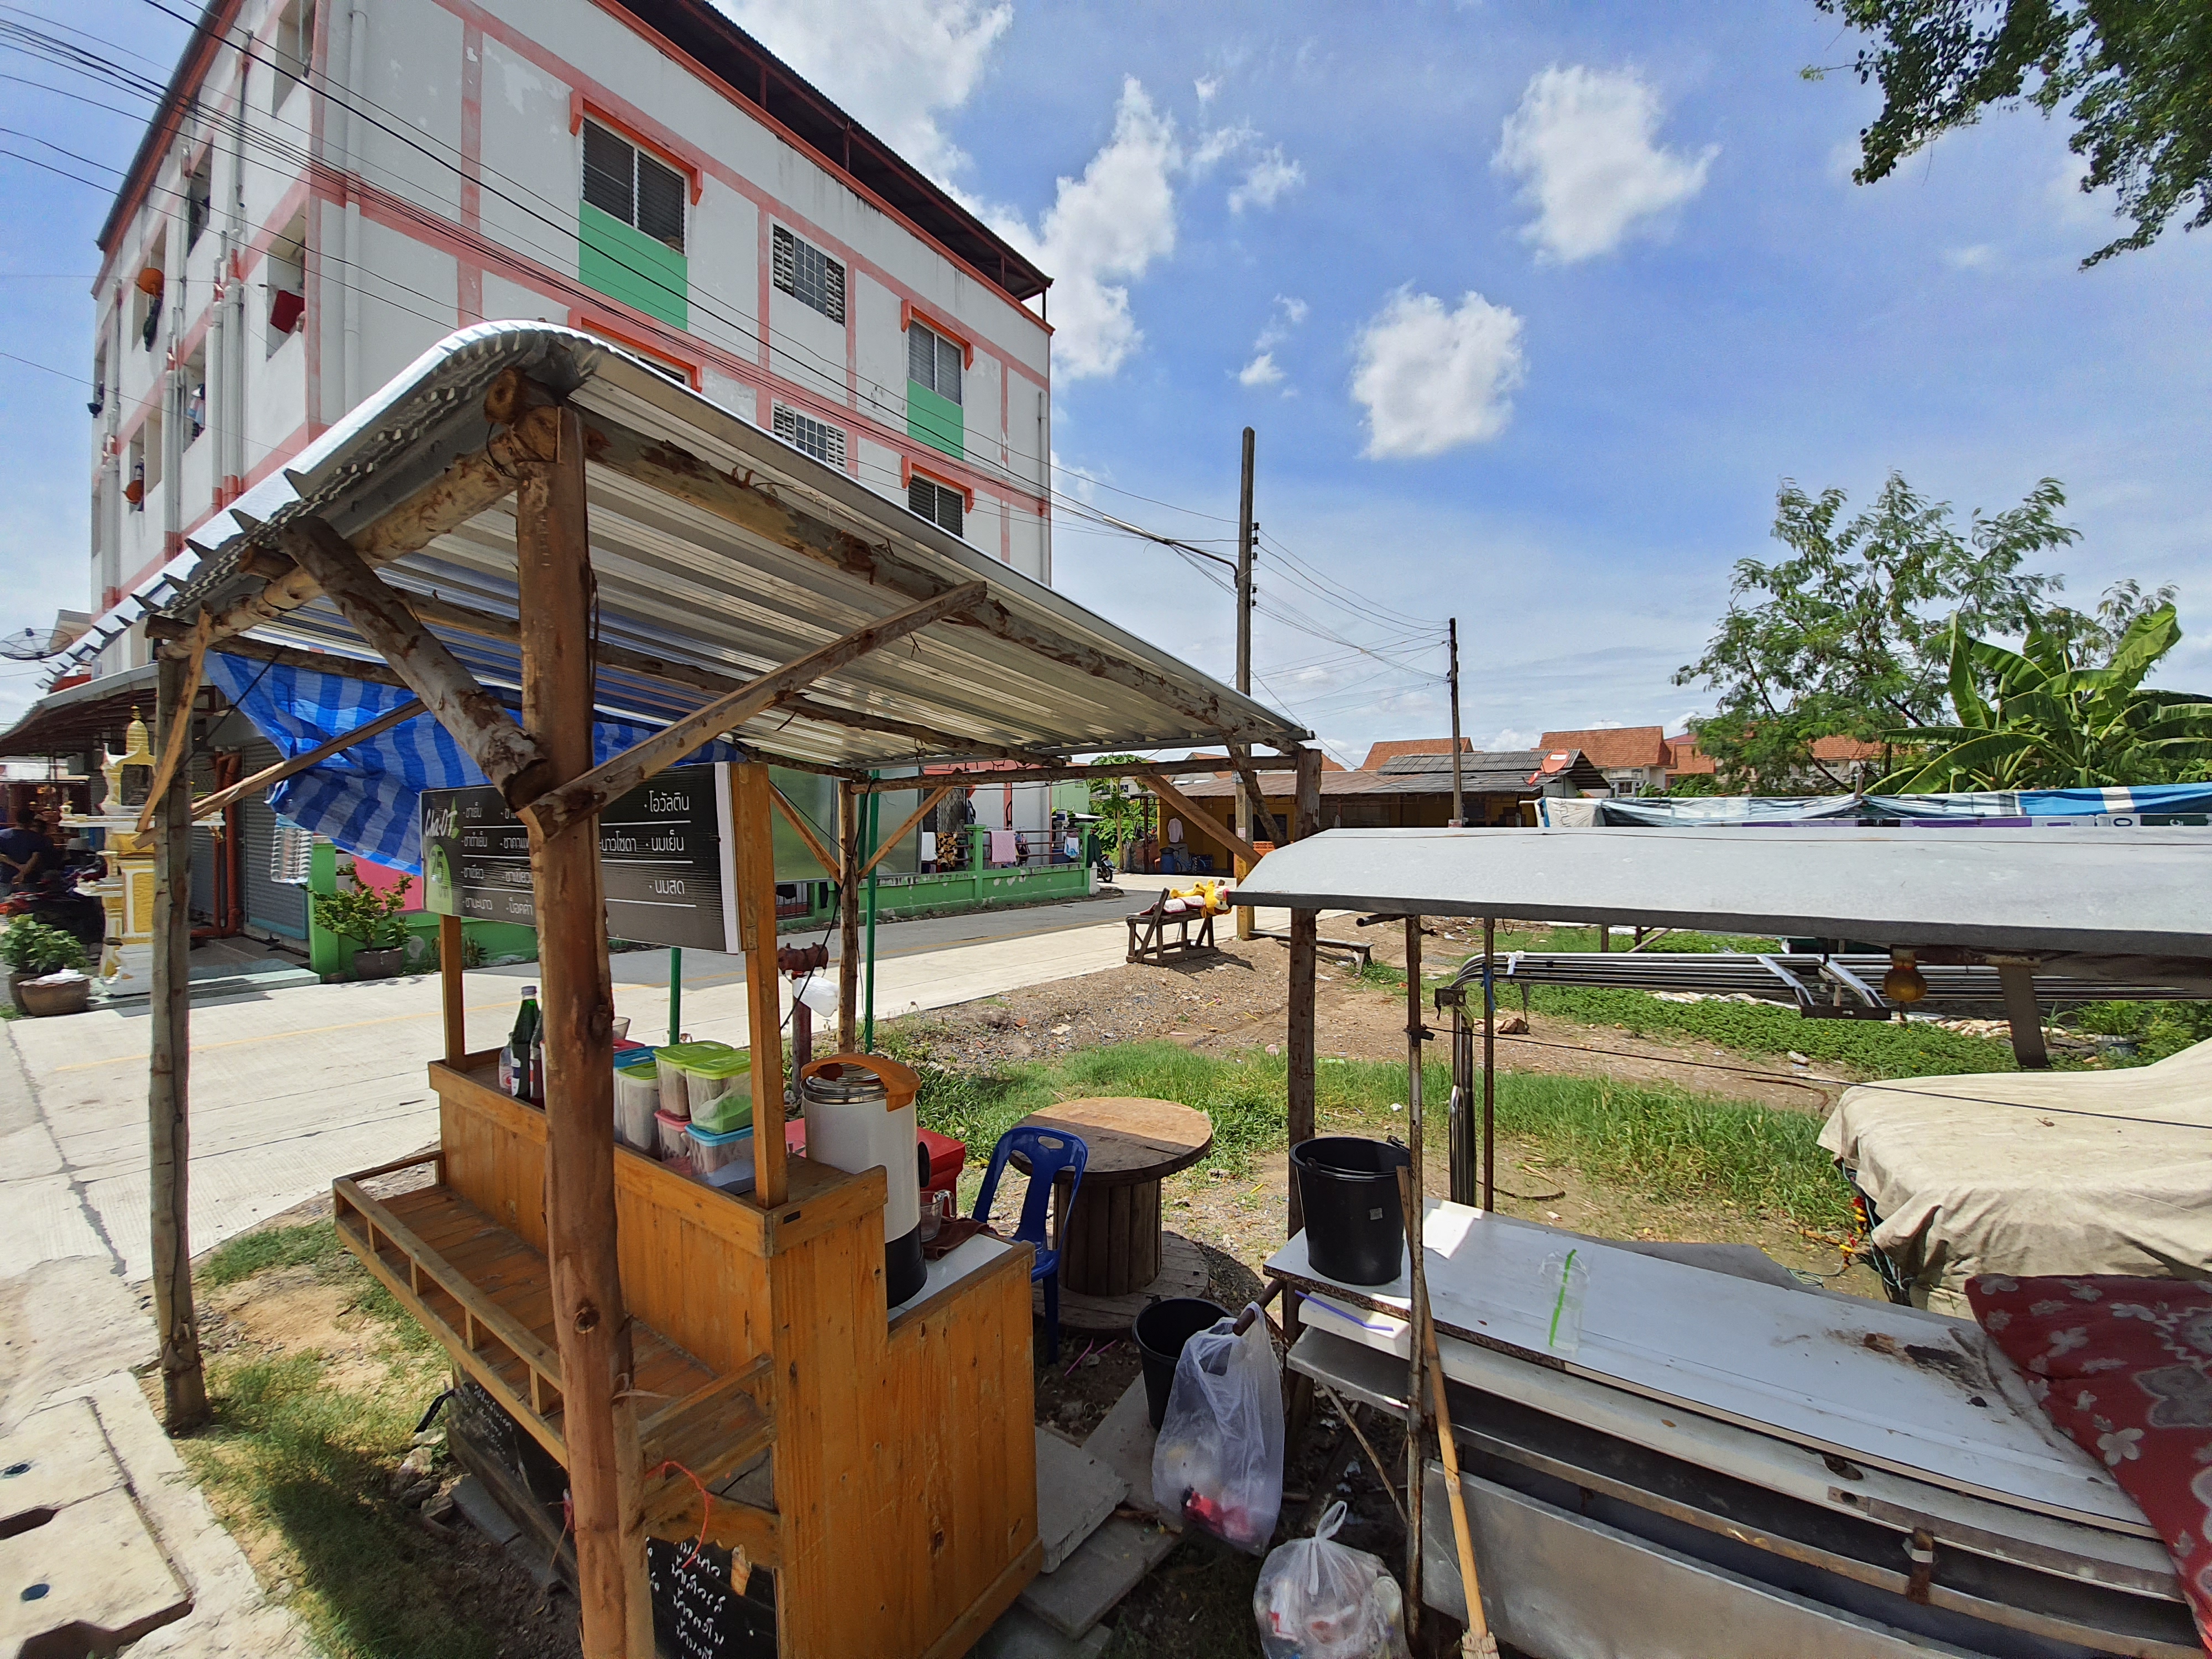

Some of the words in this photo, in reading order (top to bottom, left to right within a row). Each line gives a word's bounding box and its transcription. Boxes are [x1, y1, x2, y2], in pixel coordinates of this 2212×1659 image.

[649, 790, 690, 812] โอวัลติน
[651, 830, 685, 851] นมเย็น
[655, 880, 685, 894] นมสด
[466, 898, 493, 910] ชามะนาว
